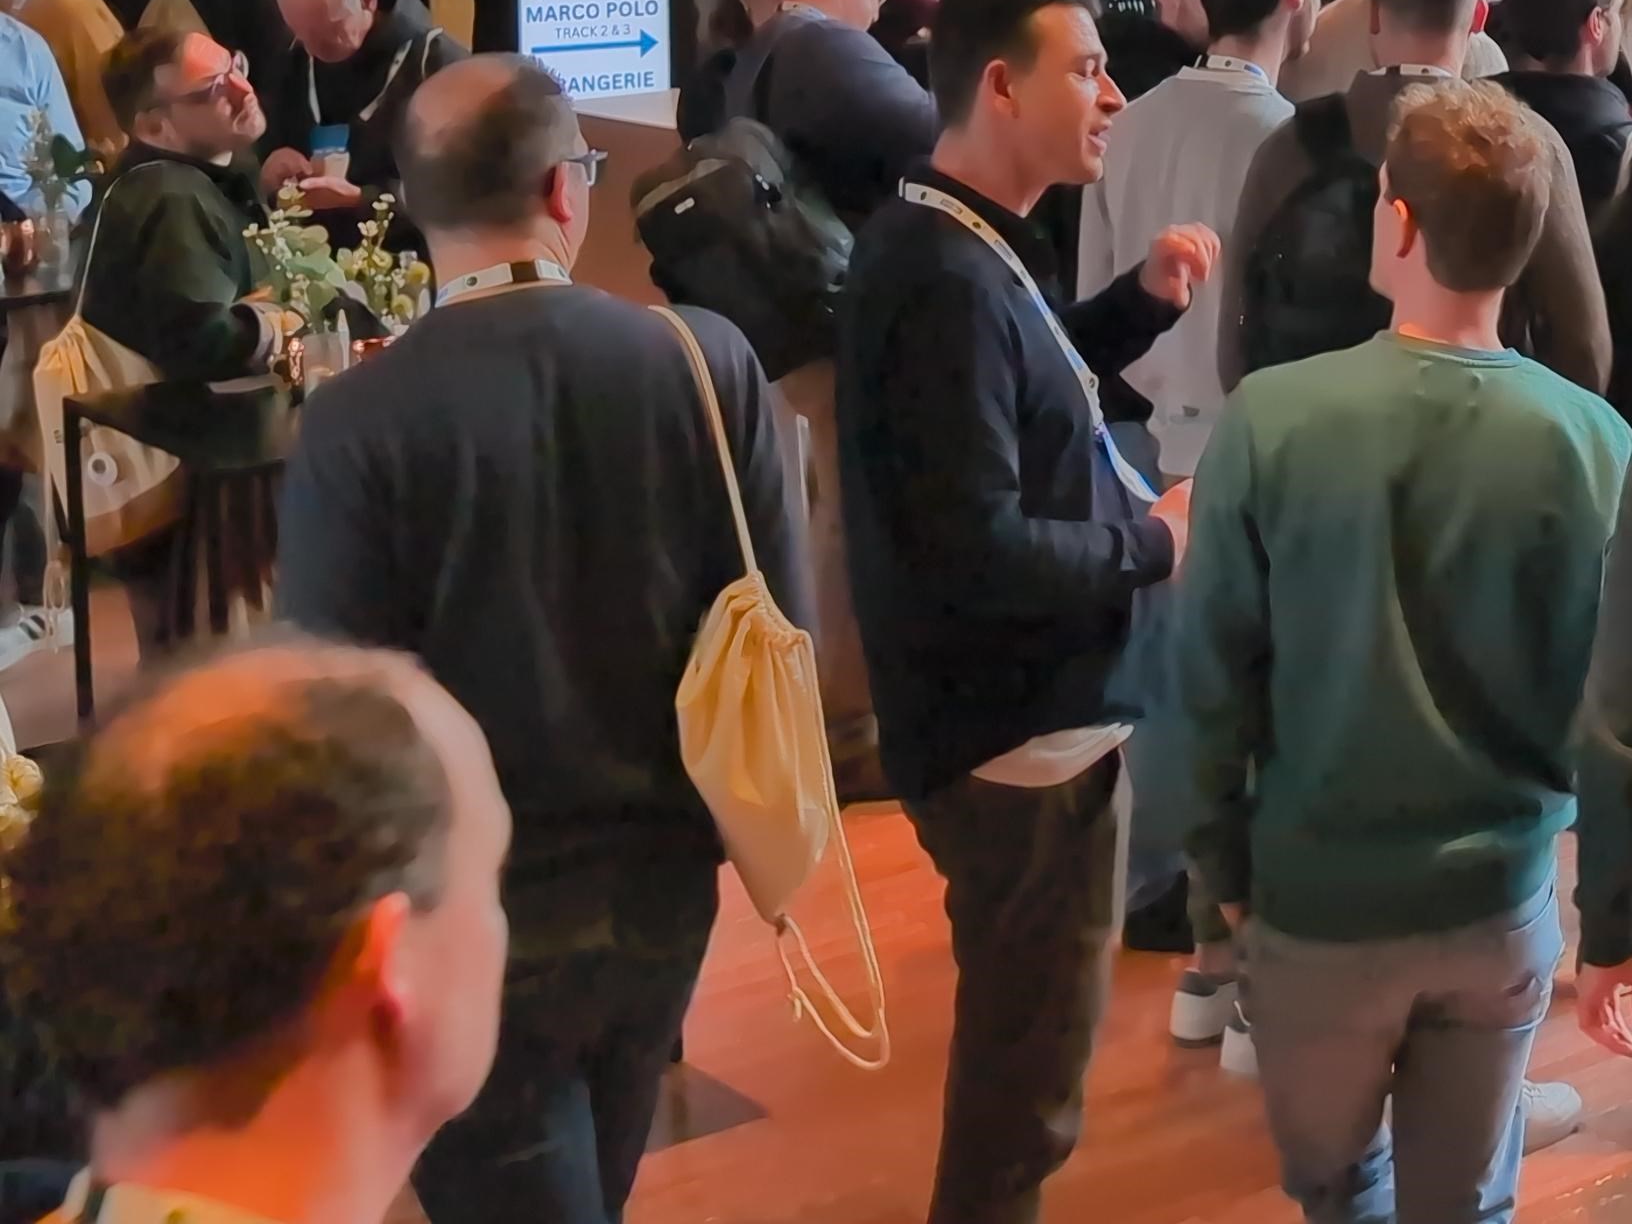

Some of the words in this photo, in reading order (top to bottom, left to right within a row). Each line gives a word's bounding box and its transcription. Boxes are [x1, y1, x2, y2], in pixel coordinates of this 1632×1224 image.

[526, 2, 600, 23] MARCO
[607, 0, 659, 18] POLO
[555, 25, 598, 40] TRACK
[601, 25, 608, 37] 2
[612, 24, 620, 36] &
[623, 23, 631, 35] 3
[560, 71, 655, 93] ANGERIE
